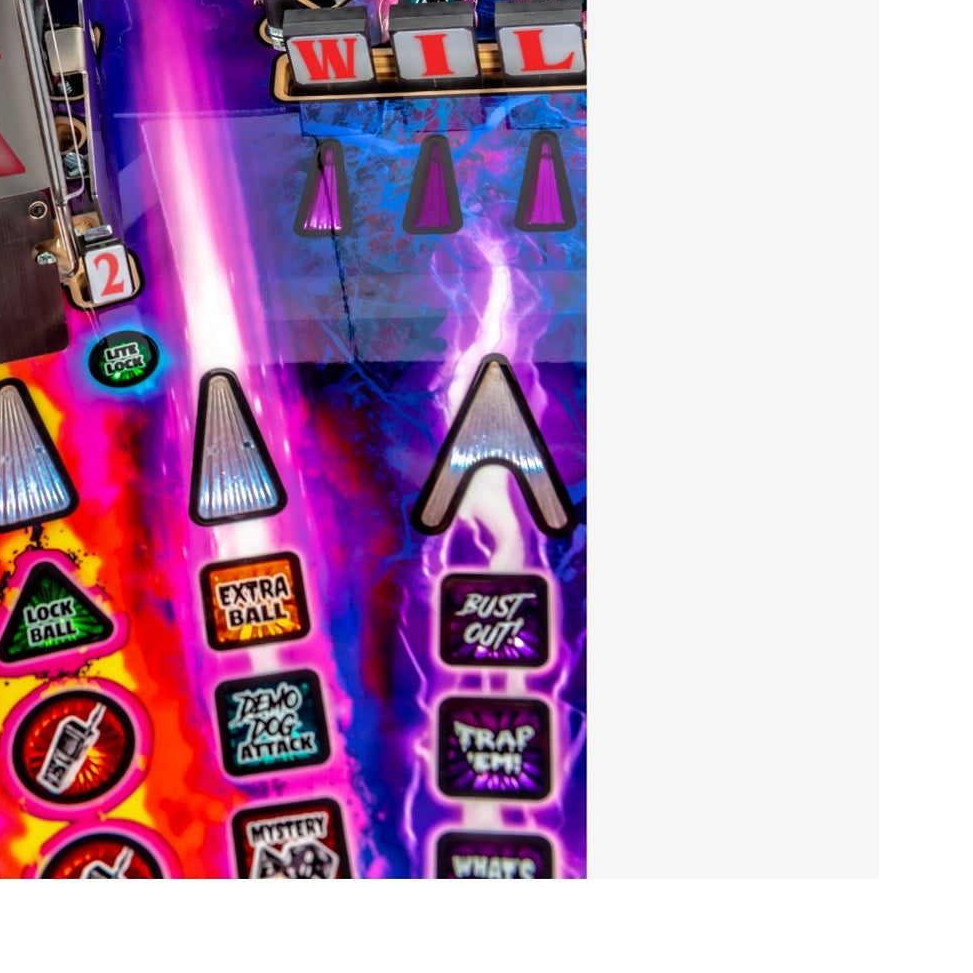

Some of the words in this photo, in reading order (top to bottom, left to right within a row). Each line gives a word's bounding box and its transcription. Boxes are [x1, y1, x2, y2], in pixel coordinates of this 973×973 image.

[93, 252, 126, 297] 2
[105, 342, 139, 361] LITE
[105, 355, 145, 376] LOCK
[218, 575, 290, 608] EXTRA
[455, 593, 537, 620] BUST
[26, 598, 75, 625] LOCK
[228, 601, 289, 629] BALL
[29, 621, 77, 646] BALL
[463, 617, 524, 650] OUT!
[232, 683, 302, 725] DEMO
[249, 714, 298, 745] DOG
[454, 720, 535, 753] TRAP
[238, 733, 317, 762] ATTACK
[248, 813, 327, 844] MYSTERY
